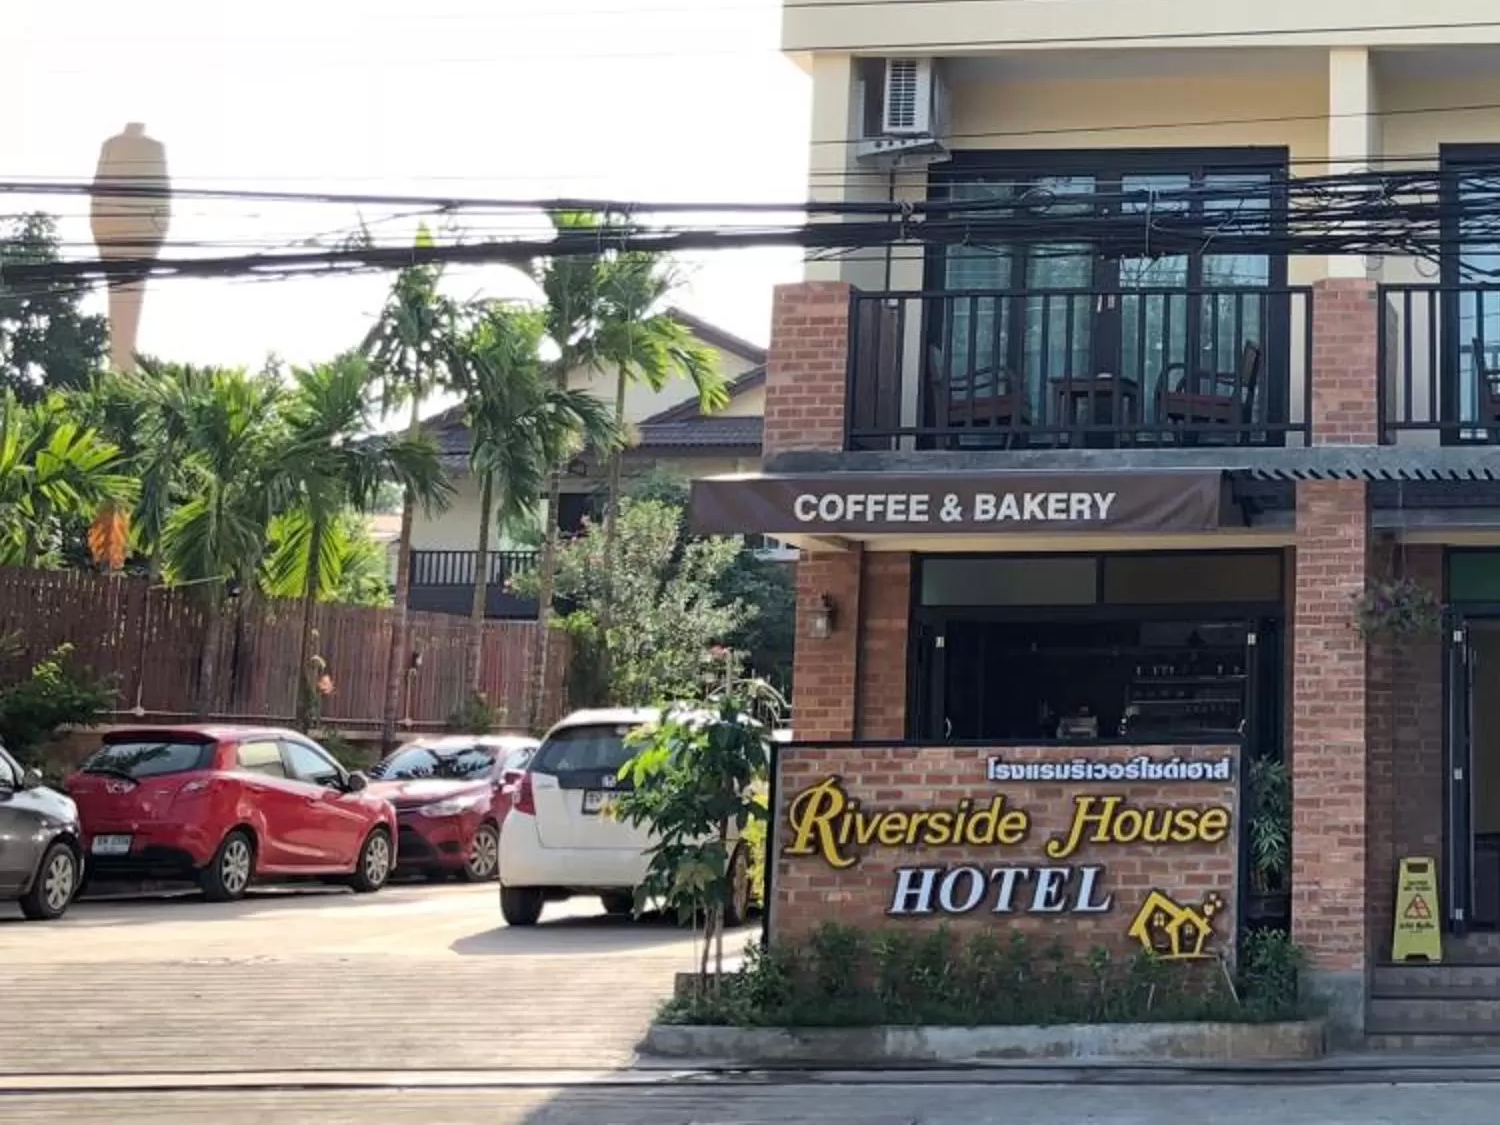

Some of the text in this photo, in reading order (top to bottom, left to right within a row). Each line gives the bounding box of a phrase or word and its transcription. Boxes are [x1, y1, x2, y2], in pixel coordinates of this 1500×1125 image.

[793, 492, 1116, 522] COFFEE & BAKERY
[784, 776, 1229, 868] Riverside House
[888, 865, 1114, 914] HOTEL
